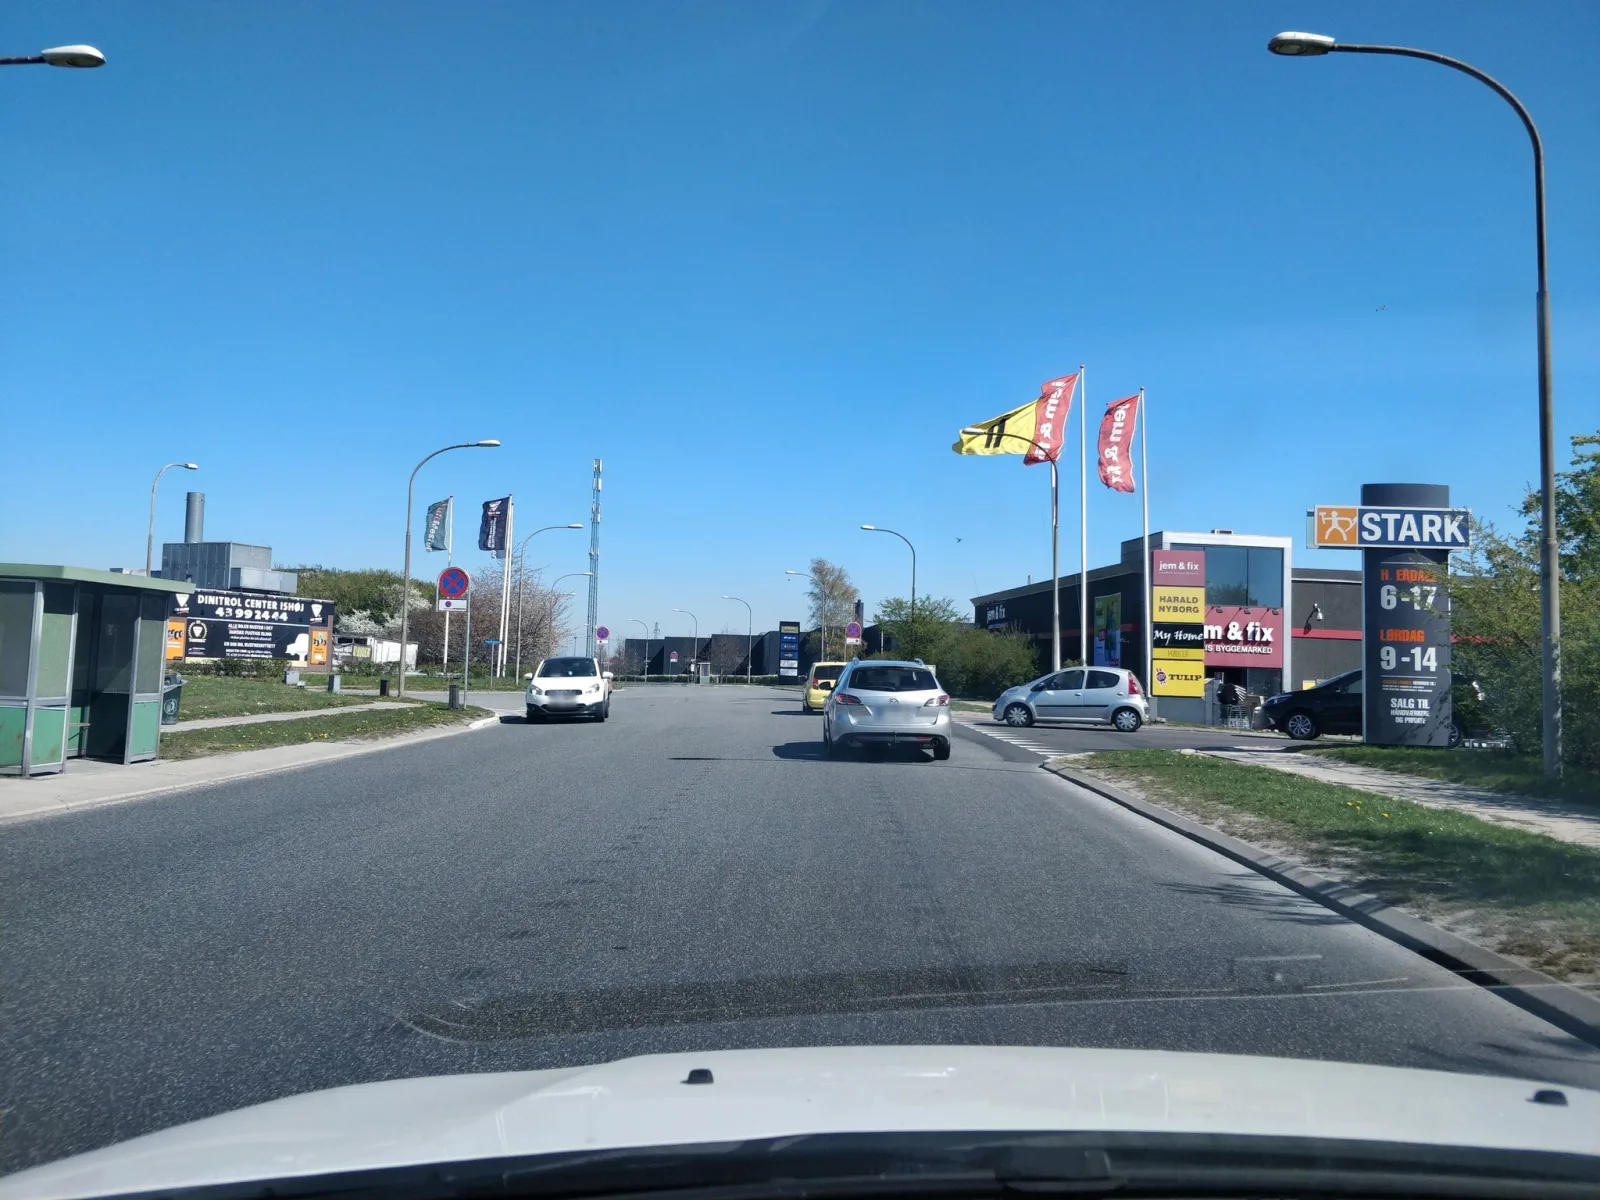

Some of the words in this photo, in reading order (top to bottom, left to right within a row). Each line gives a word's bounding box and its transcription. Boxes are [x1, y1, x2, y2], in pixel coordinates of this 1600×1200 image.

[1104, 445, 1119, 462] &
[1361, 512, 1466, 543] STARK
[1159, 560, 1177, 571] jem
[1178, 561, 1186, 570] &
[1186, 561, 1199, 571] fix
[197, 594, 242, 607] DINITROL
[244, 599, 278, 610] CENTER
[280, 601, 305, 612] ISHØJ
[1153, 629, 1171, 646] My
[1173, 630, 1204, 640] Home
[1226, 621, 1244, 641] &
[1246, 621, 1274, 642] fix
[1380, 629, 1425, 642] LØRDAG
[1215, 645, 1273, 654] BYGGEMARKED
[1390, 698, 1415, 709] SALG
[1417, 698, 1430, 709] TIL
